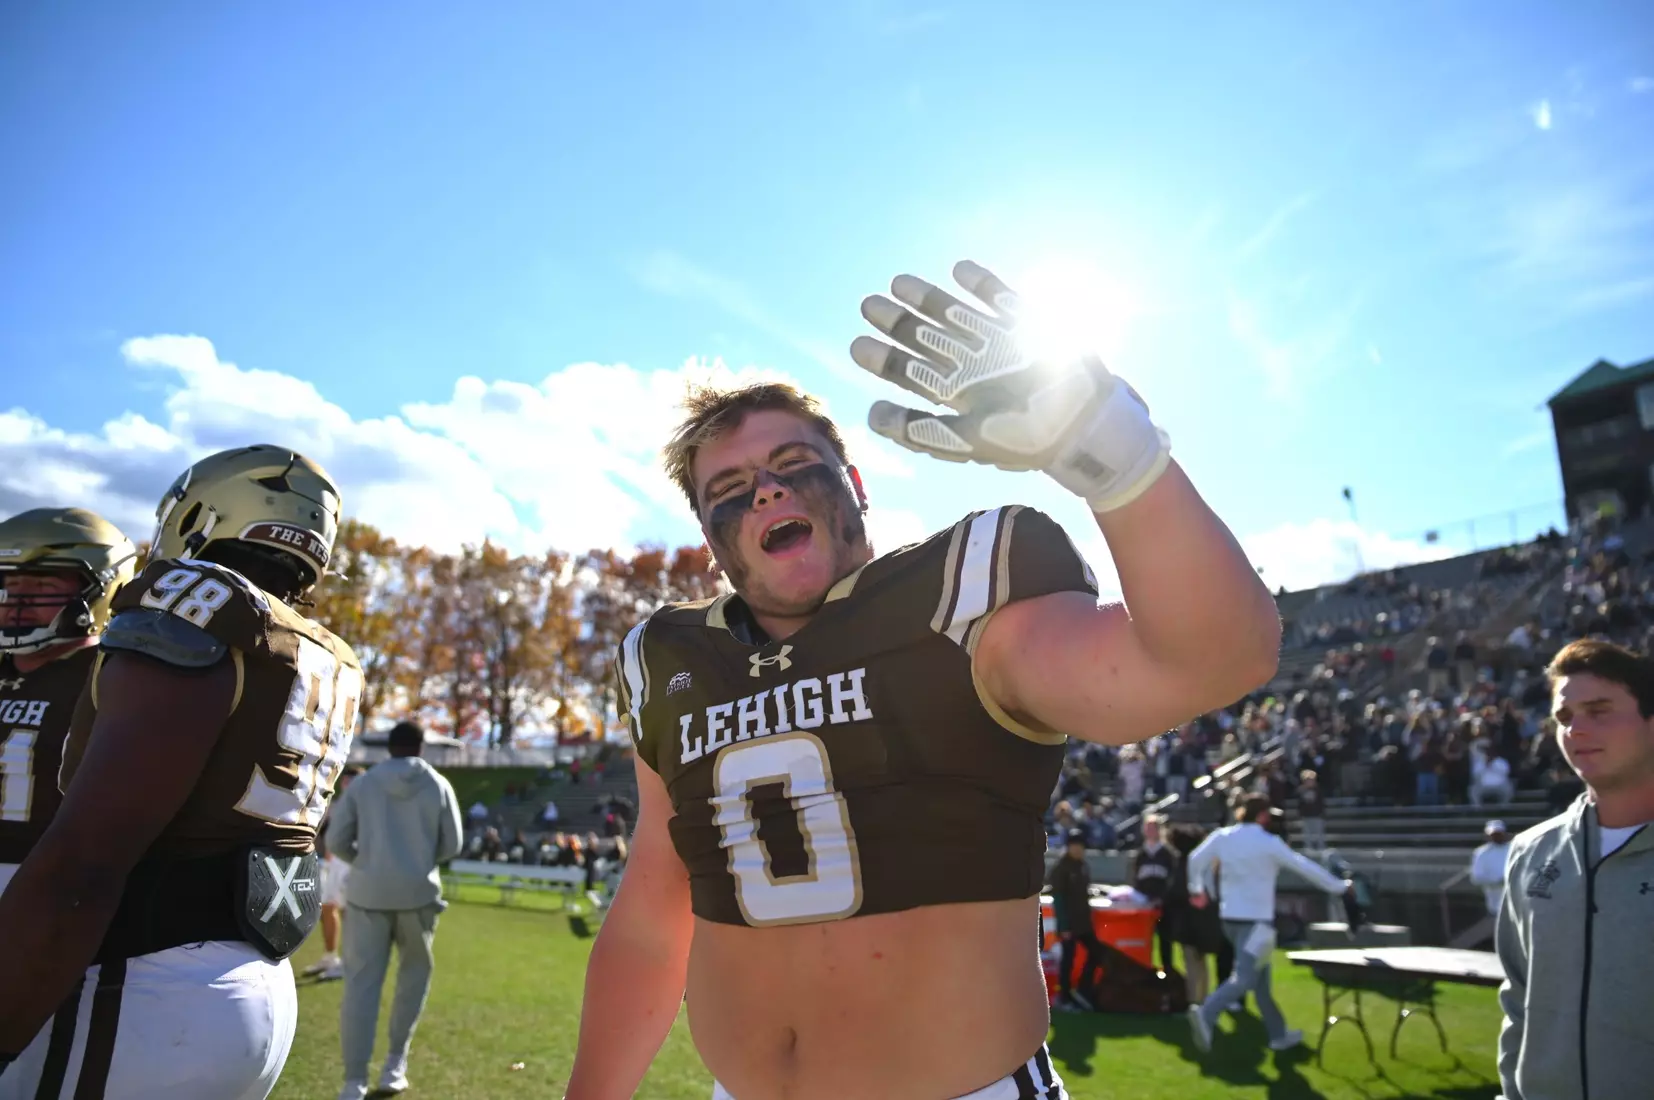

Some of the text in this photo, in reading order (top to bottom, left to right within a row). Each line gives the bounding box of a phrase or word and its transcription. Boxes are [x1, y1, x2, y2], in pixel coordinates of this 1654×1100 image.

[269, 526, 329, 563] THE NES
[140, 569, 233, 629] 98
[679, 667, 874, 765] LEHIGH
[708, 731, 864, 928] 0
